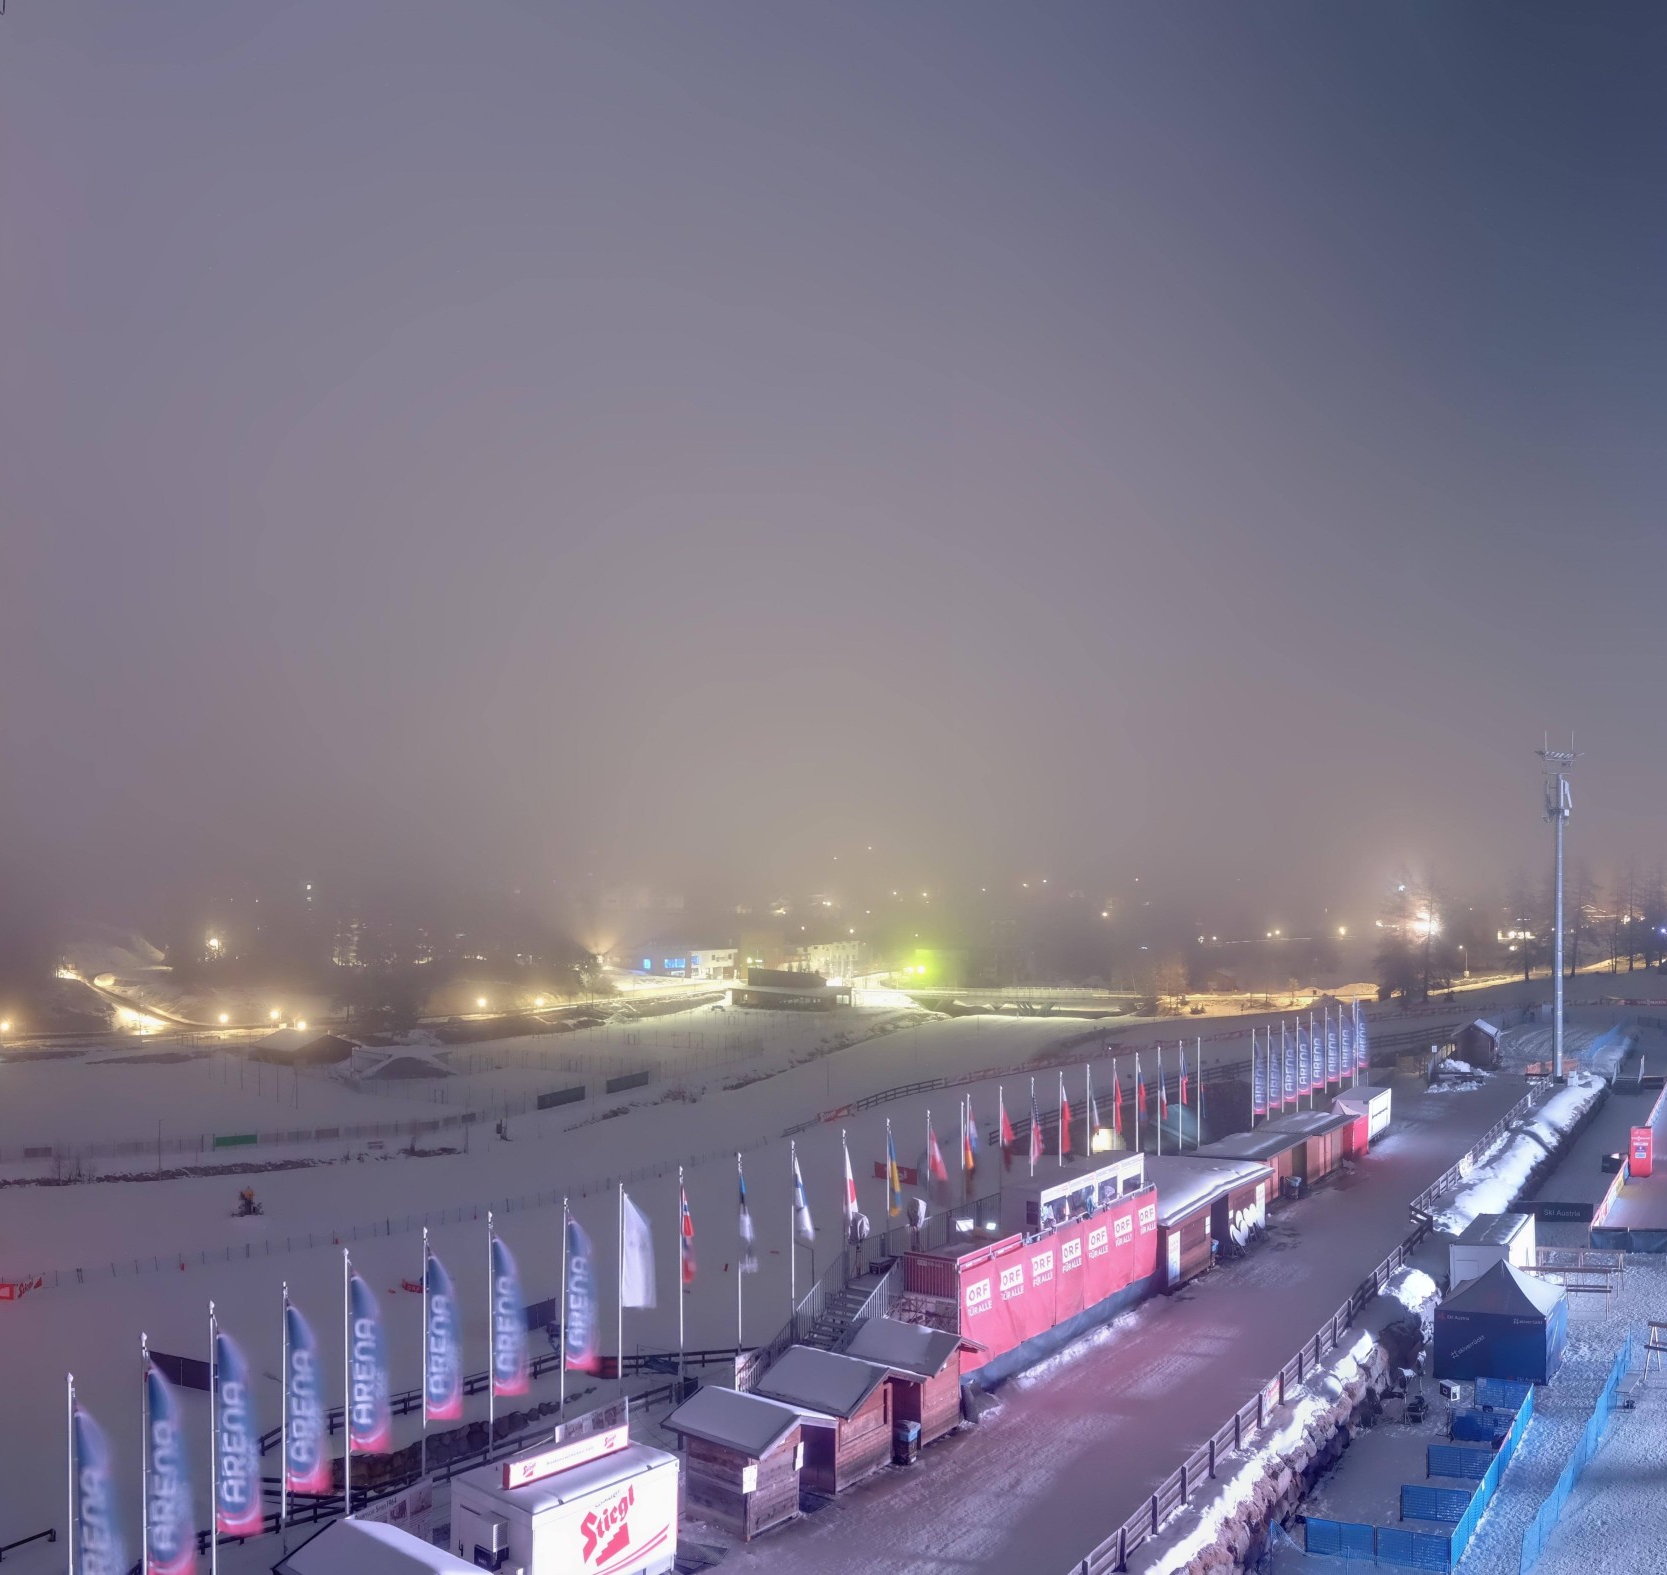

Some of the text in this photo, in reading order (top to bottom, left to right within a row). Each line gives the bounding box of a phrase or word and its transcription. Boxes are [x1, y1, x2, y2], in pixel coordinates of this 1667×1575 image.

[1313, 1037, 1322, 1078] ARENA
[1328, 1032, 1337, 1072] ARENA
[1341, 1029, 1351, 1068] ARENA
[1358, 1022, 1367, 1063] ARENA
[1284, 1049, 1295, 1092] ARENA
[1298, 1043, 1307, 1085] ARENA
[1115, 1219, 1131, 1233] ORF
[1139, 1207, 1155, 1222] ORF
[1543, 1208, 1581, 1218] Ski Austria
[1063, 1242, 1079, 1258] ORF
[1090, 1230, 1106, 1246] ORF
[1003, 1269, 1021, 1286] ORF
[1033, 1255, 1051, 1271] ORF
[568, 1256, 589, 1347] ARENA
[968, 1283, 988, 1301] ORF
[429, 1294, 452, 1394] ARENA
[353, 1318, 376, 1425] ARENA
[222, 1381, 248, 1503] ARENA
[79, 1467, 110, 1575] RENA
[580, 1483, 634, 1564] Stiegl
